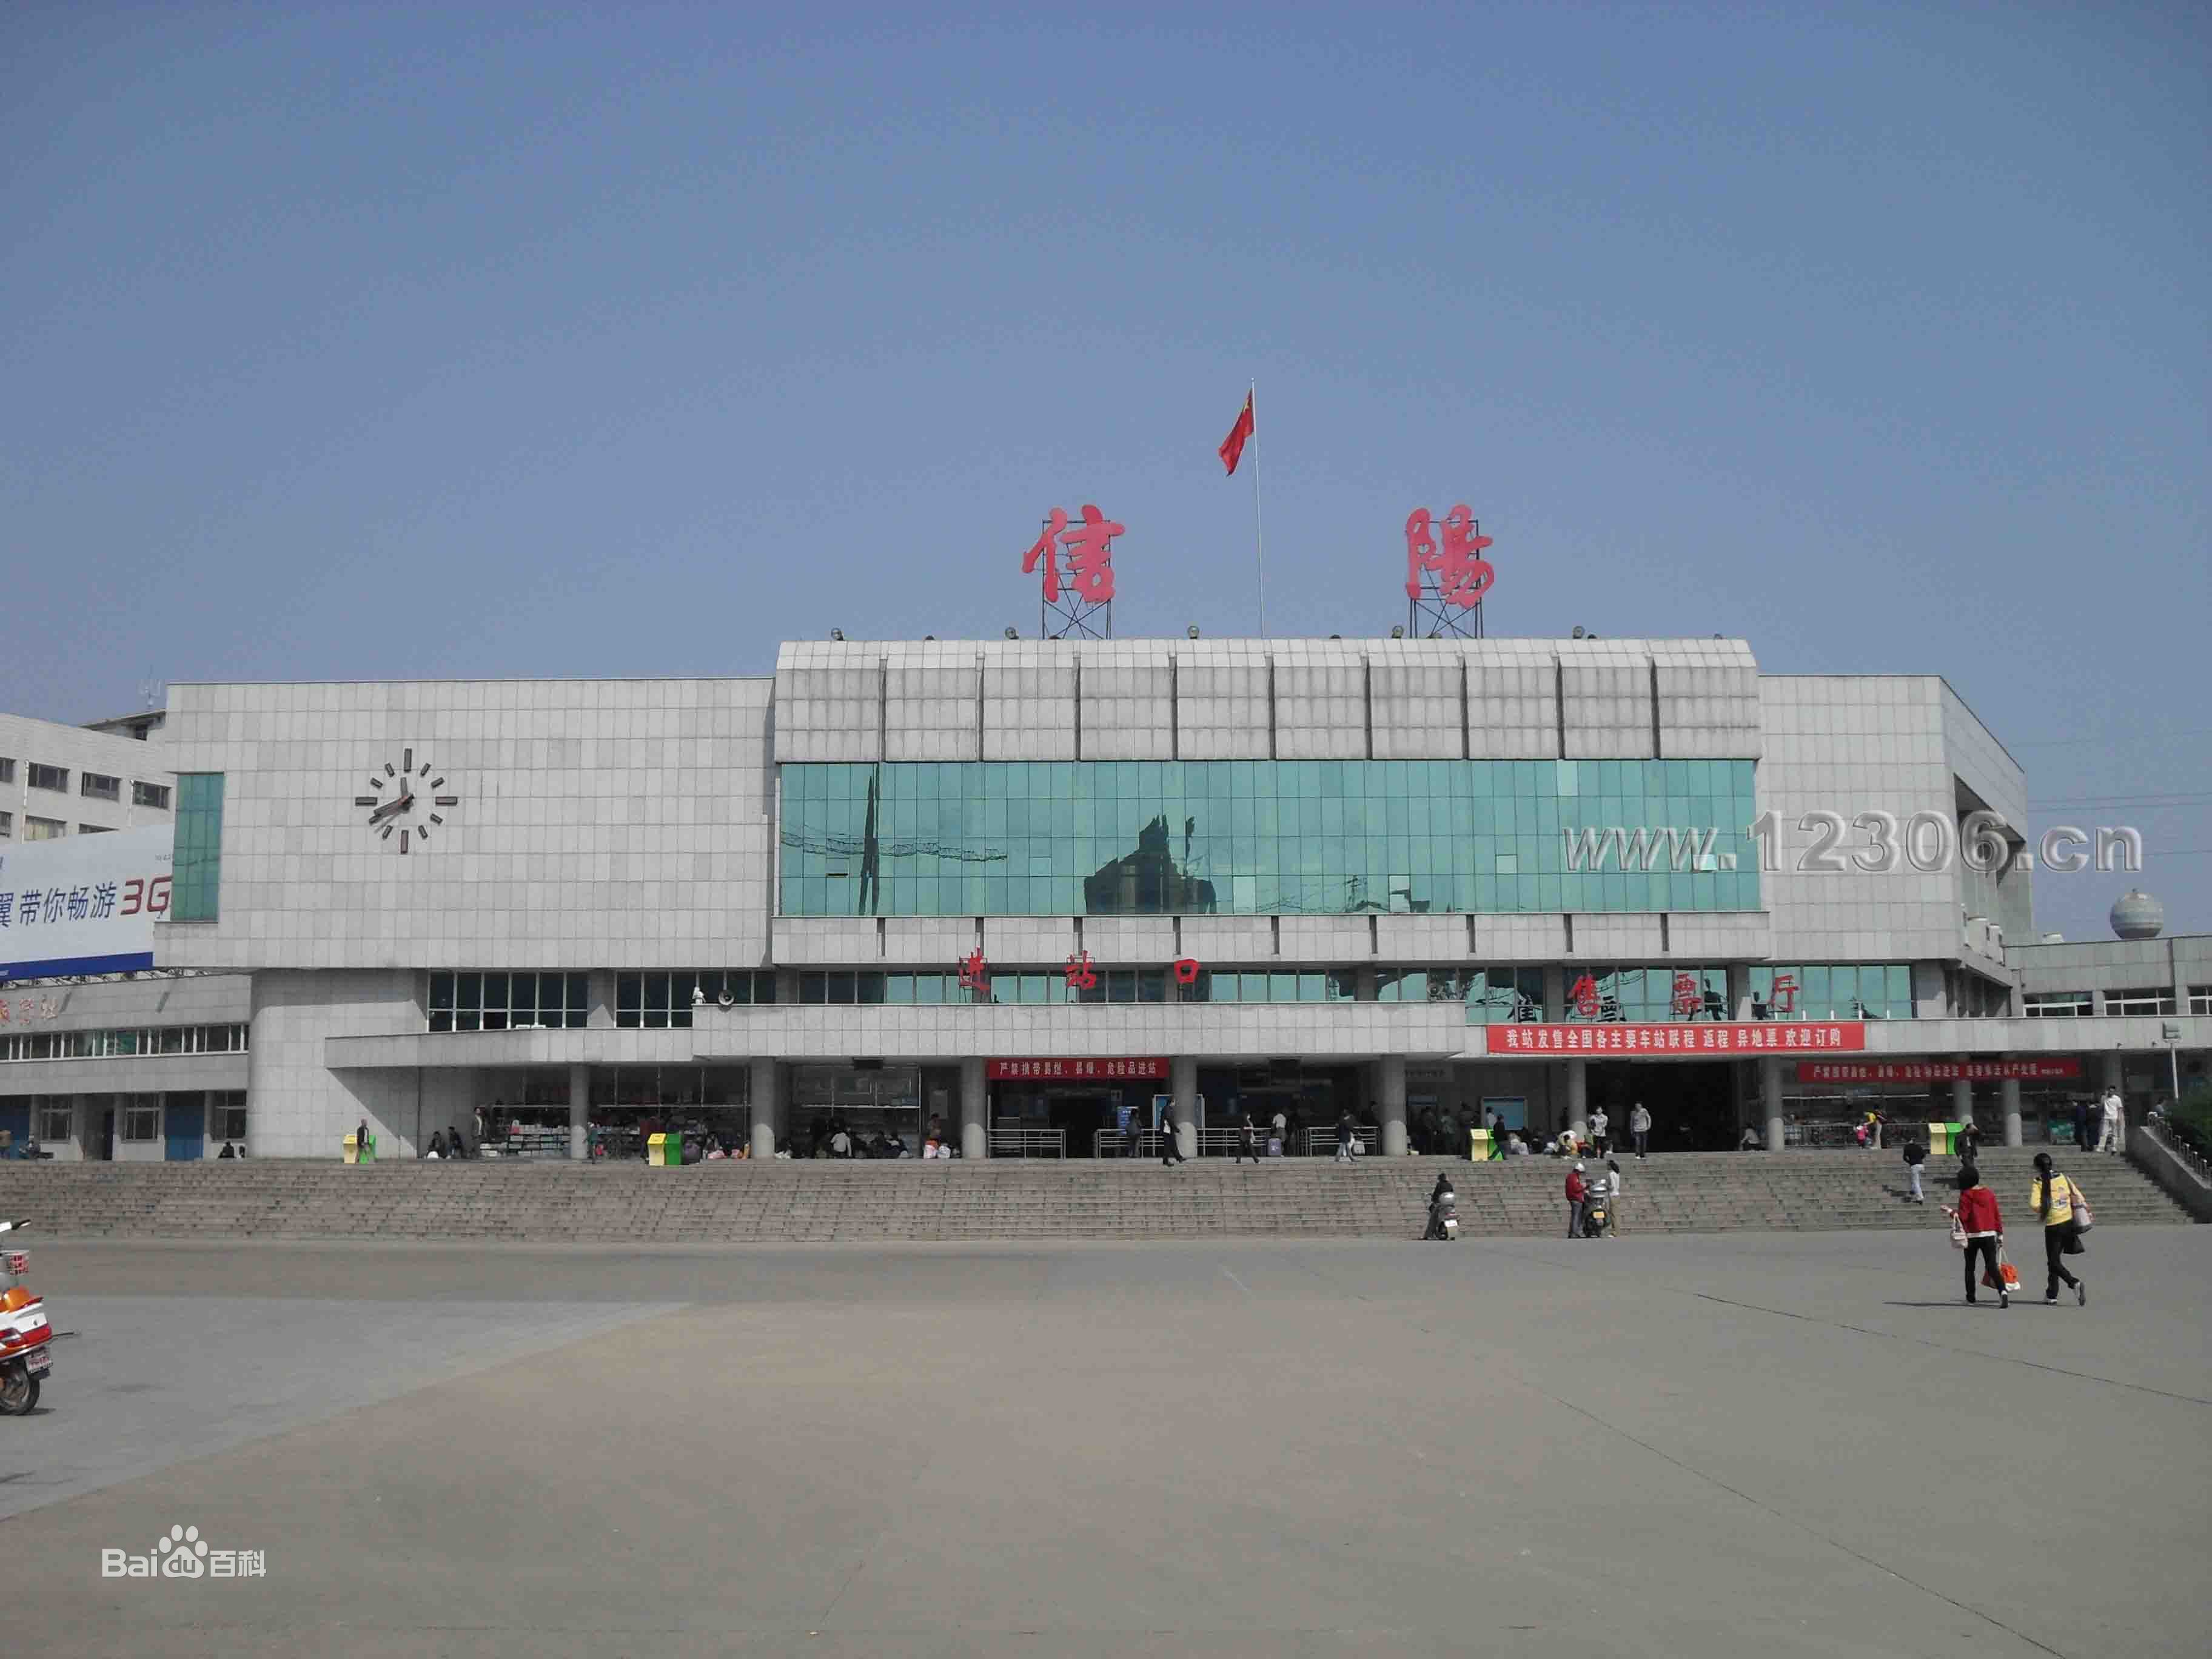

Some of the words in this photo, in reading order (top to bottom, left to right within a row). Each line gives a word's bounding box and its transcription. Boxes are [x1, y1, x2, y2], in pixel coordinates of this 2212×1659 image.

[958, 947, 1200, 992] 进站口
[1567, 972, 1799, 1018] 售票厅
[1737, 1028, 1777, 1048] 异地票
[1785, 1028, 1842, 1047] 欢迎订购
